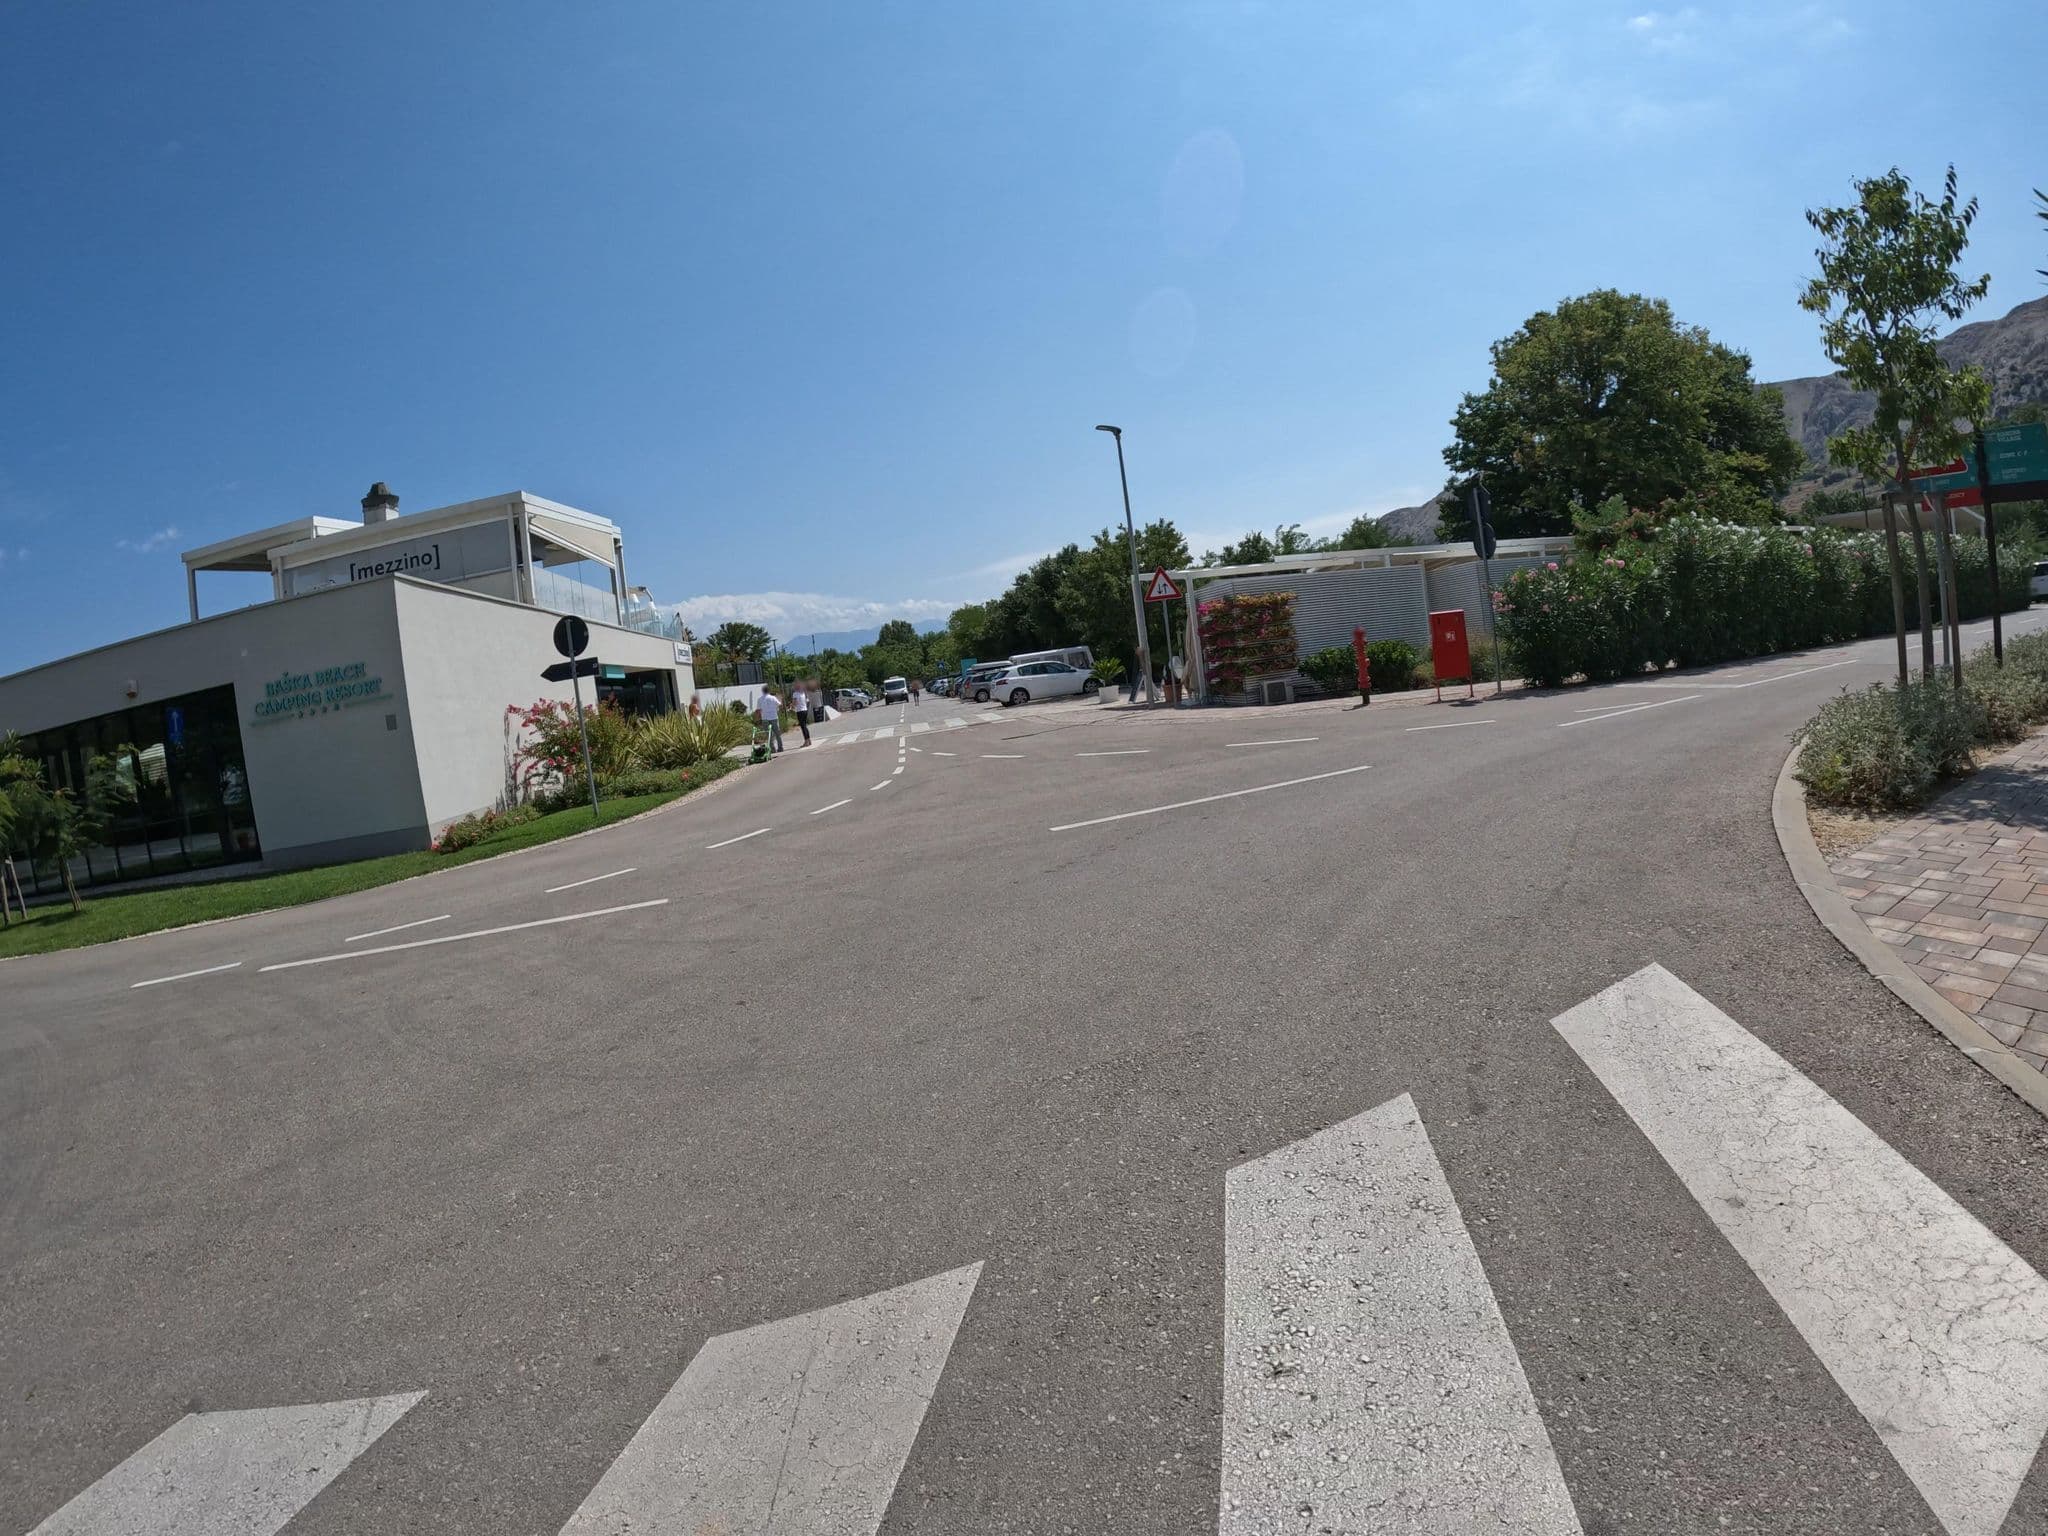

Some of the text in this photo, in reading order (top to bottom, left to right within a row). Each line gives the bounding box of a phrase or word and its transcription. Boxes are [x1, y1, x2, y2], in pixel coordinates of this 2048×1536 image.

[350, 544, 440, 581] [mezzino]
[315, 662, 366, 686] BEACH
[255, 677, 382, 716] CAMPING RESORT
